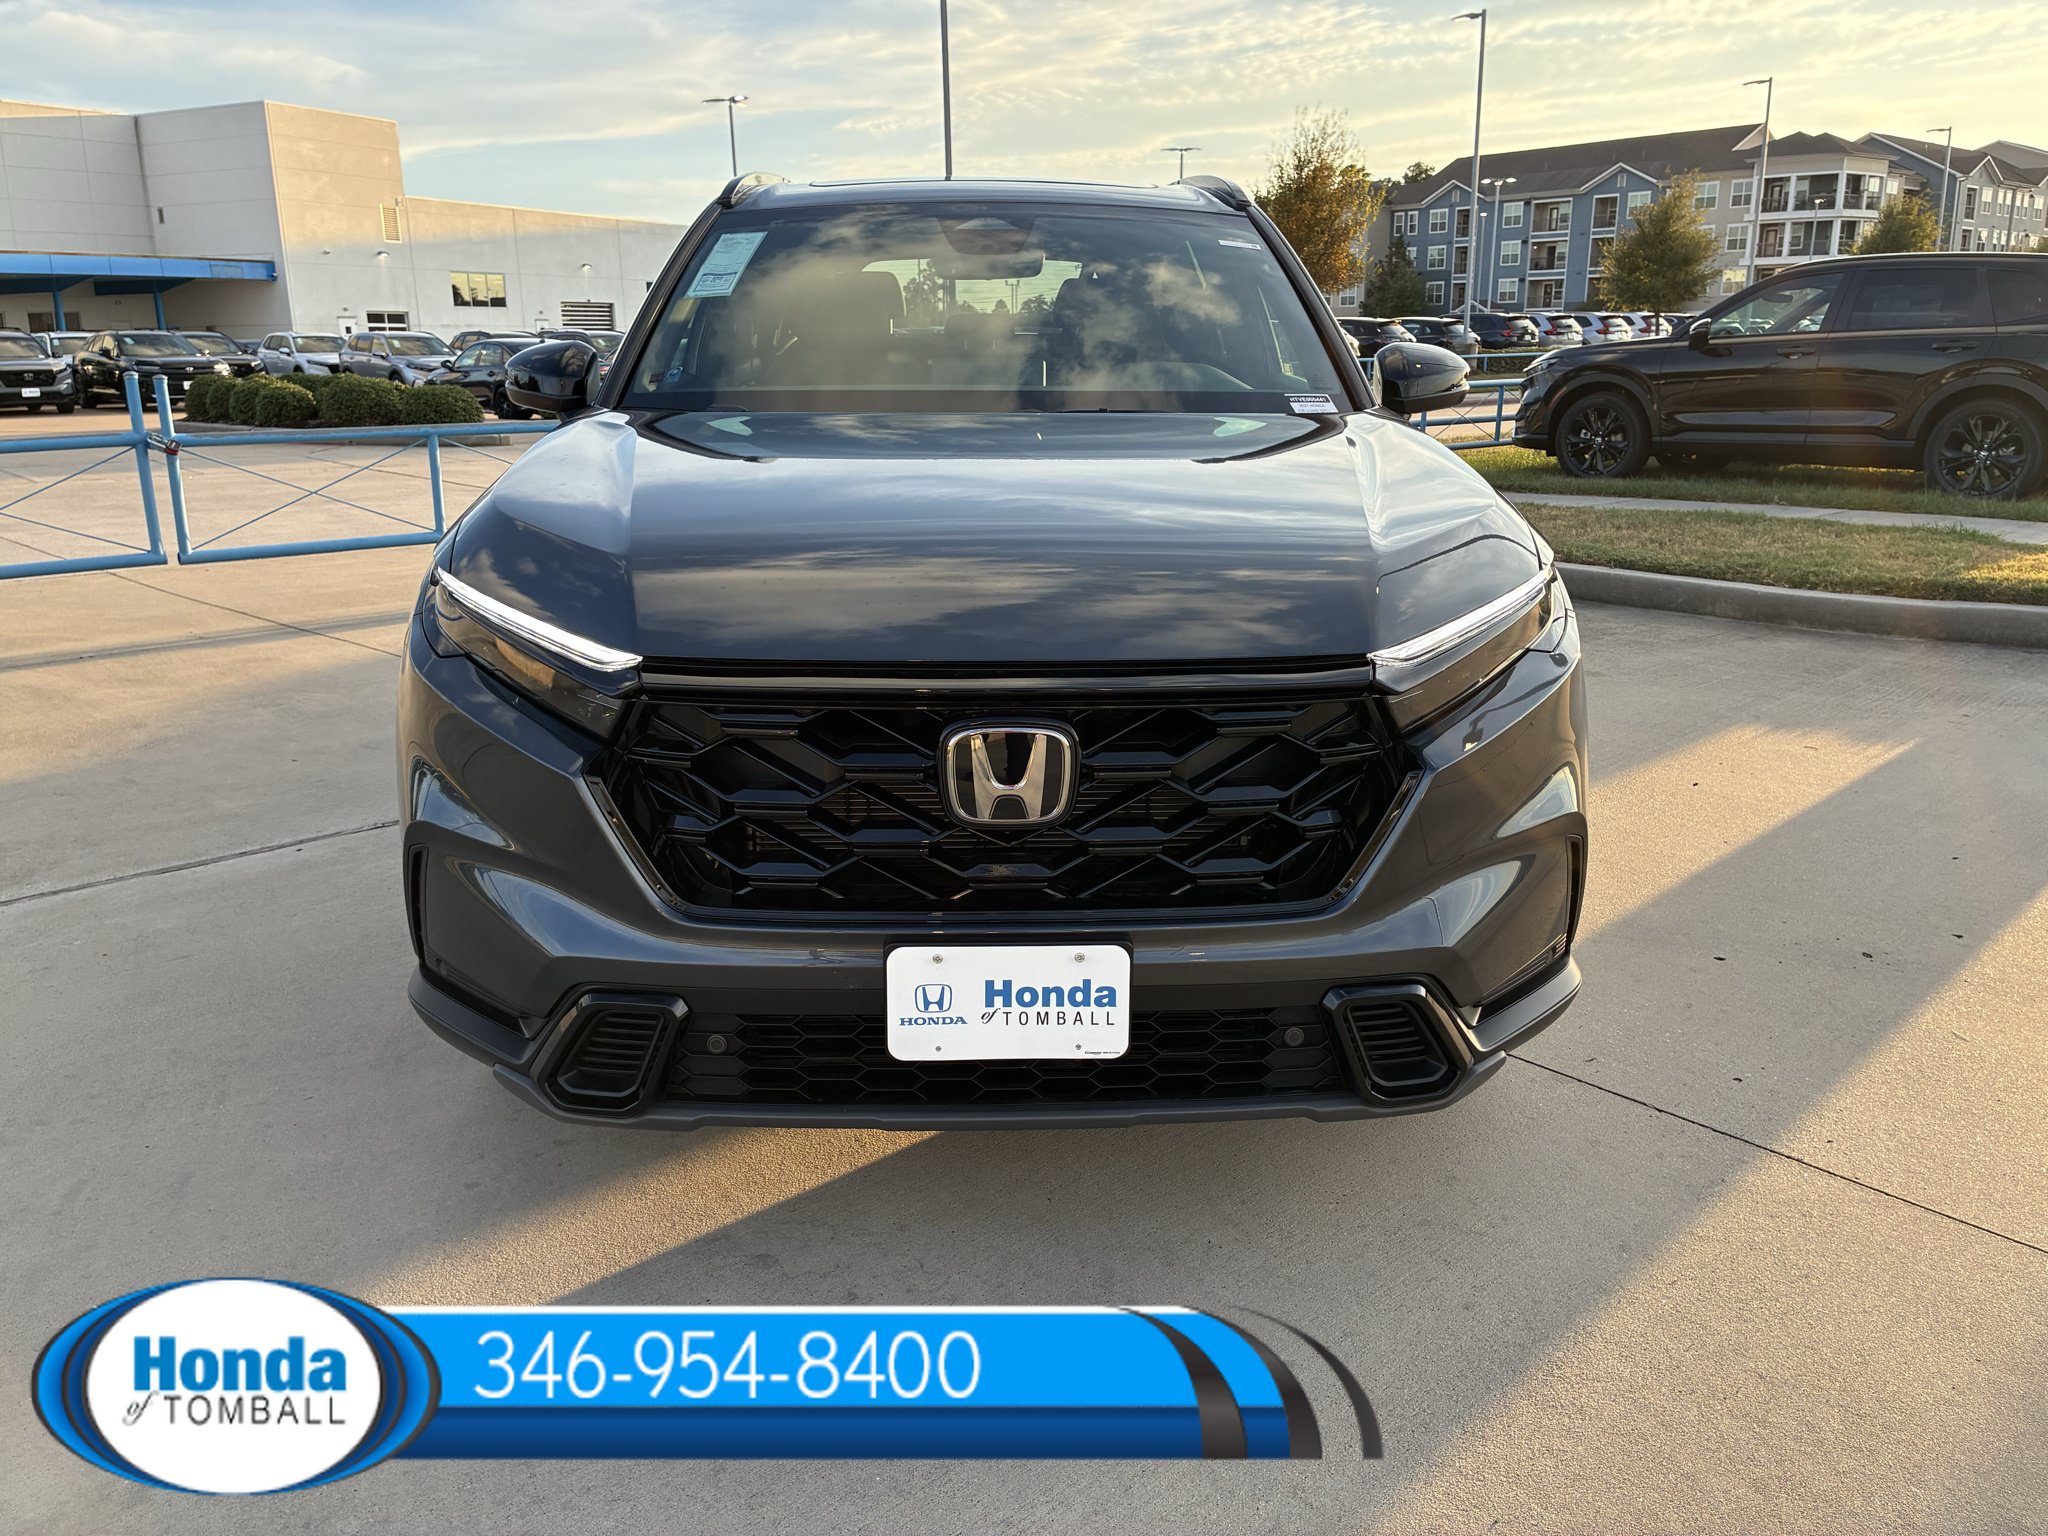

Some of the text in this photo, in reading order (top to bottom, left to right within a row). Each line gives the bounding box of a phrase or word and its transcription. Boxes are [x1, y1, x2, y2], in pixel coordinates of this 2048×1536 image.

[984, 979, 1117, 1008] Honda
[899, 1016, 968, 1026] HONDA
[980, 1008, 1115, 1026] of TOMBALL
